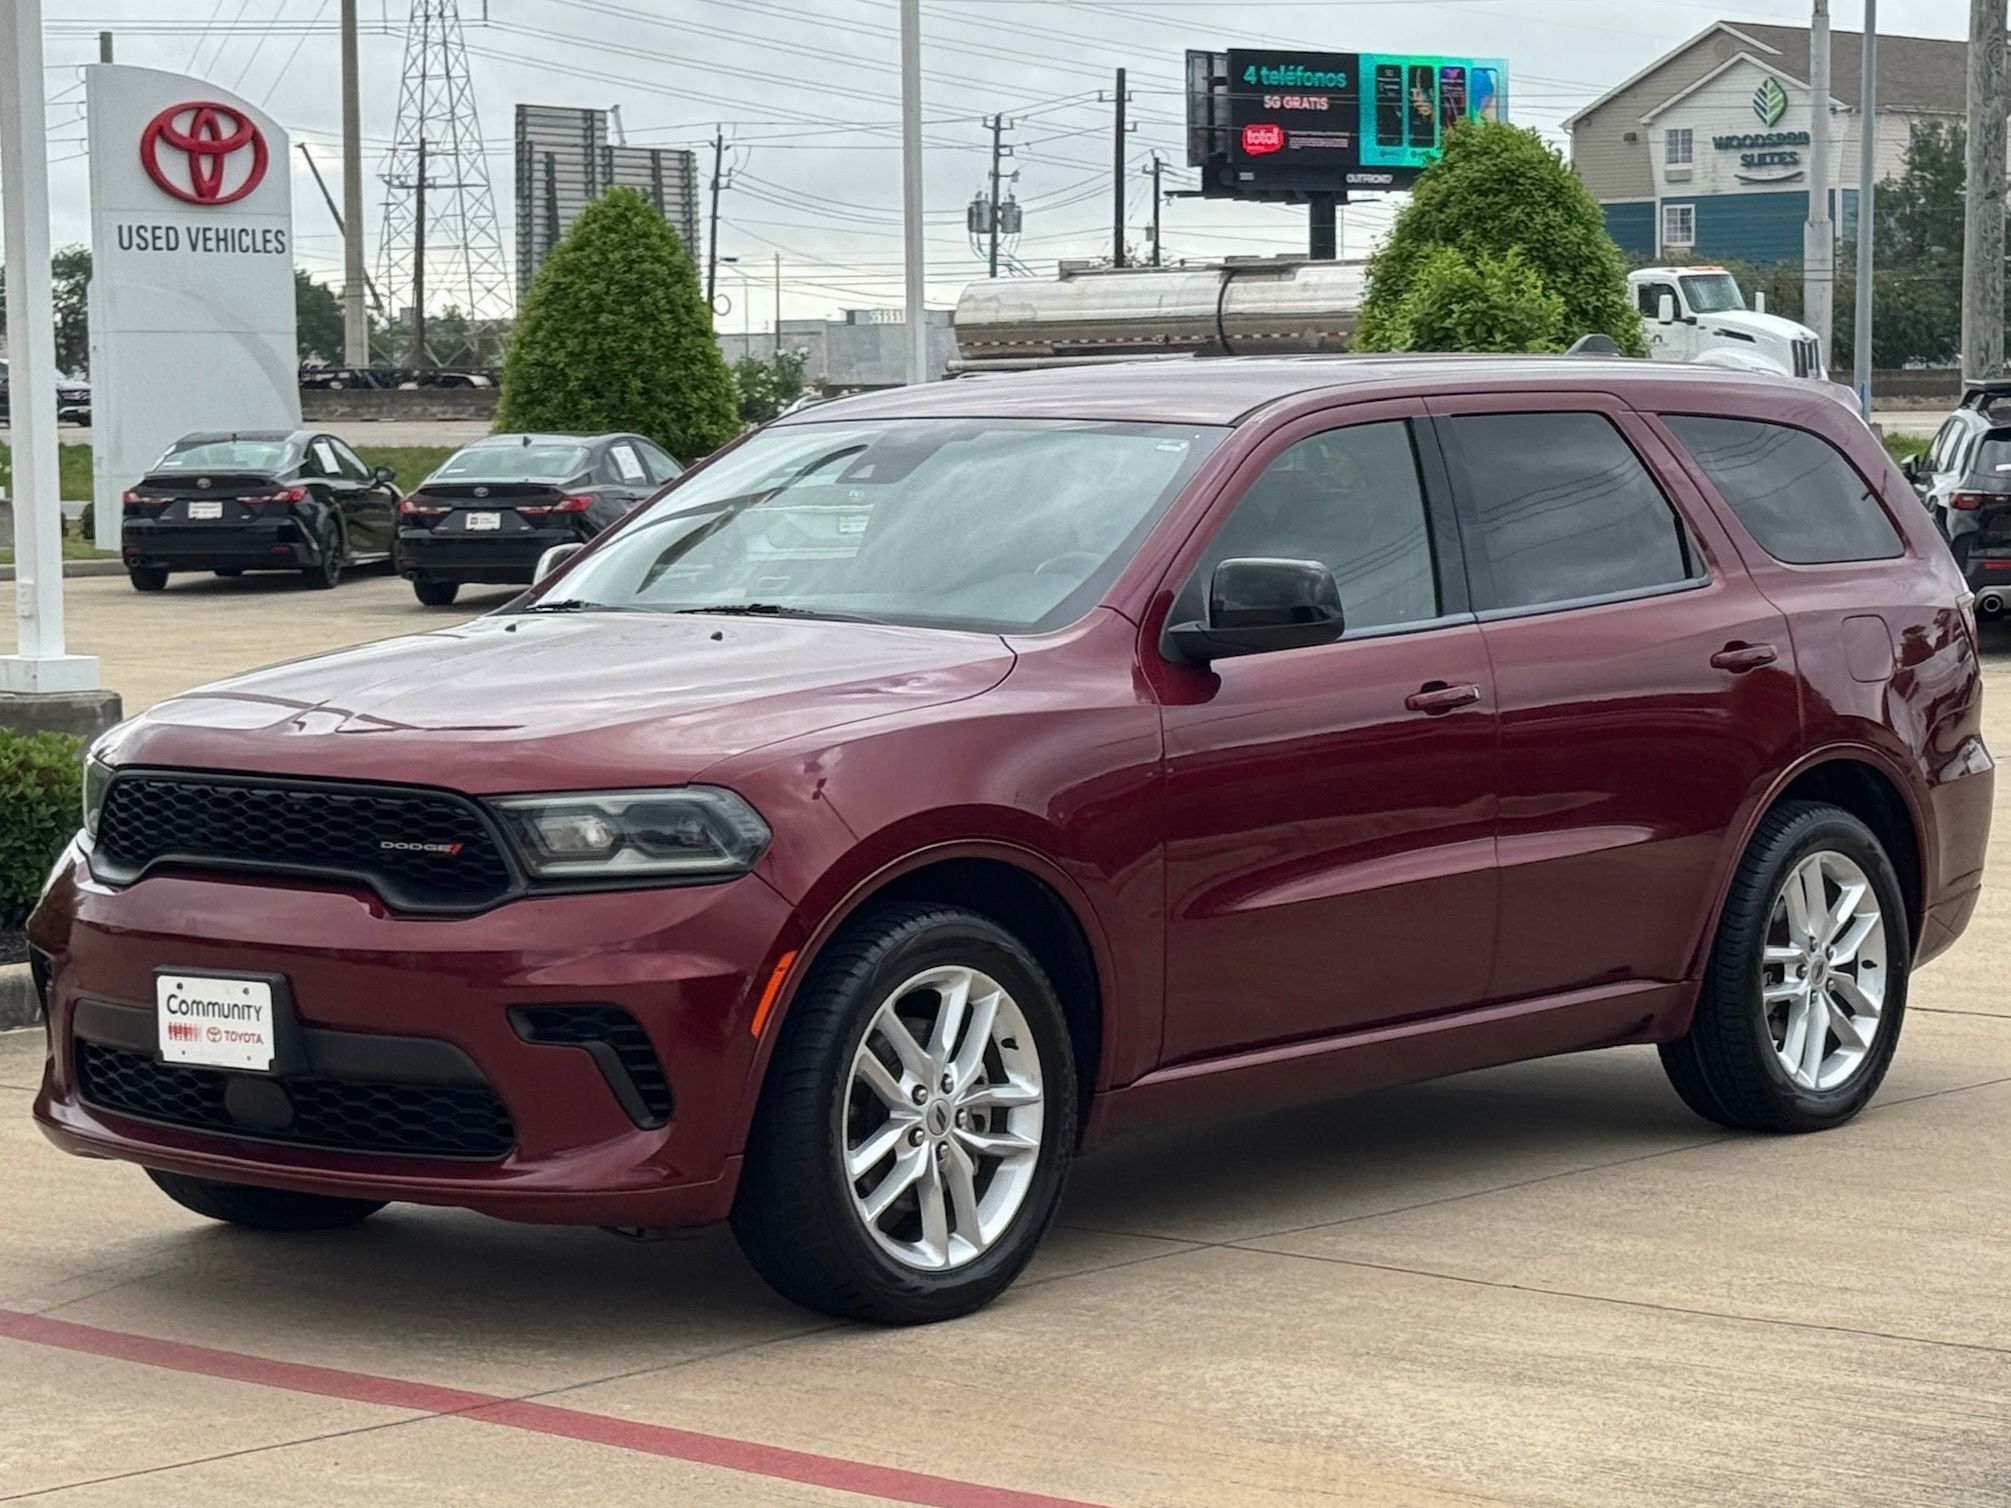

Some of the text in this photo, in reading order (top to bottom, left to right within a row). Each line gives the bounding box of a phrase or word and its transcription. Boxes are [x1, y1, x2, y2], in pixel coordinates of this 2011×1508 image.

[1243, 65, 1348, 88] 4 teléfonos
[1263, 95, 1329, 111] 5G GRATIS
[1740, 151, 1799, 167] SUITES
[117, 224, 287, 254] USED VEHICLES
[380, 841, 451, 853] DODGE
[223, 1030, 264, 1045] TOYOTA
